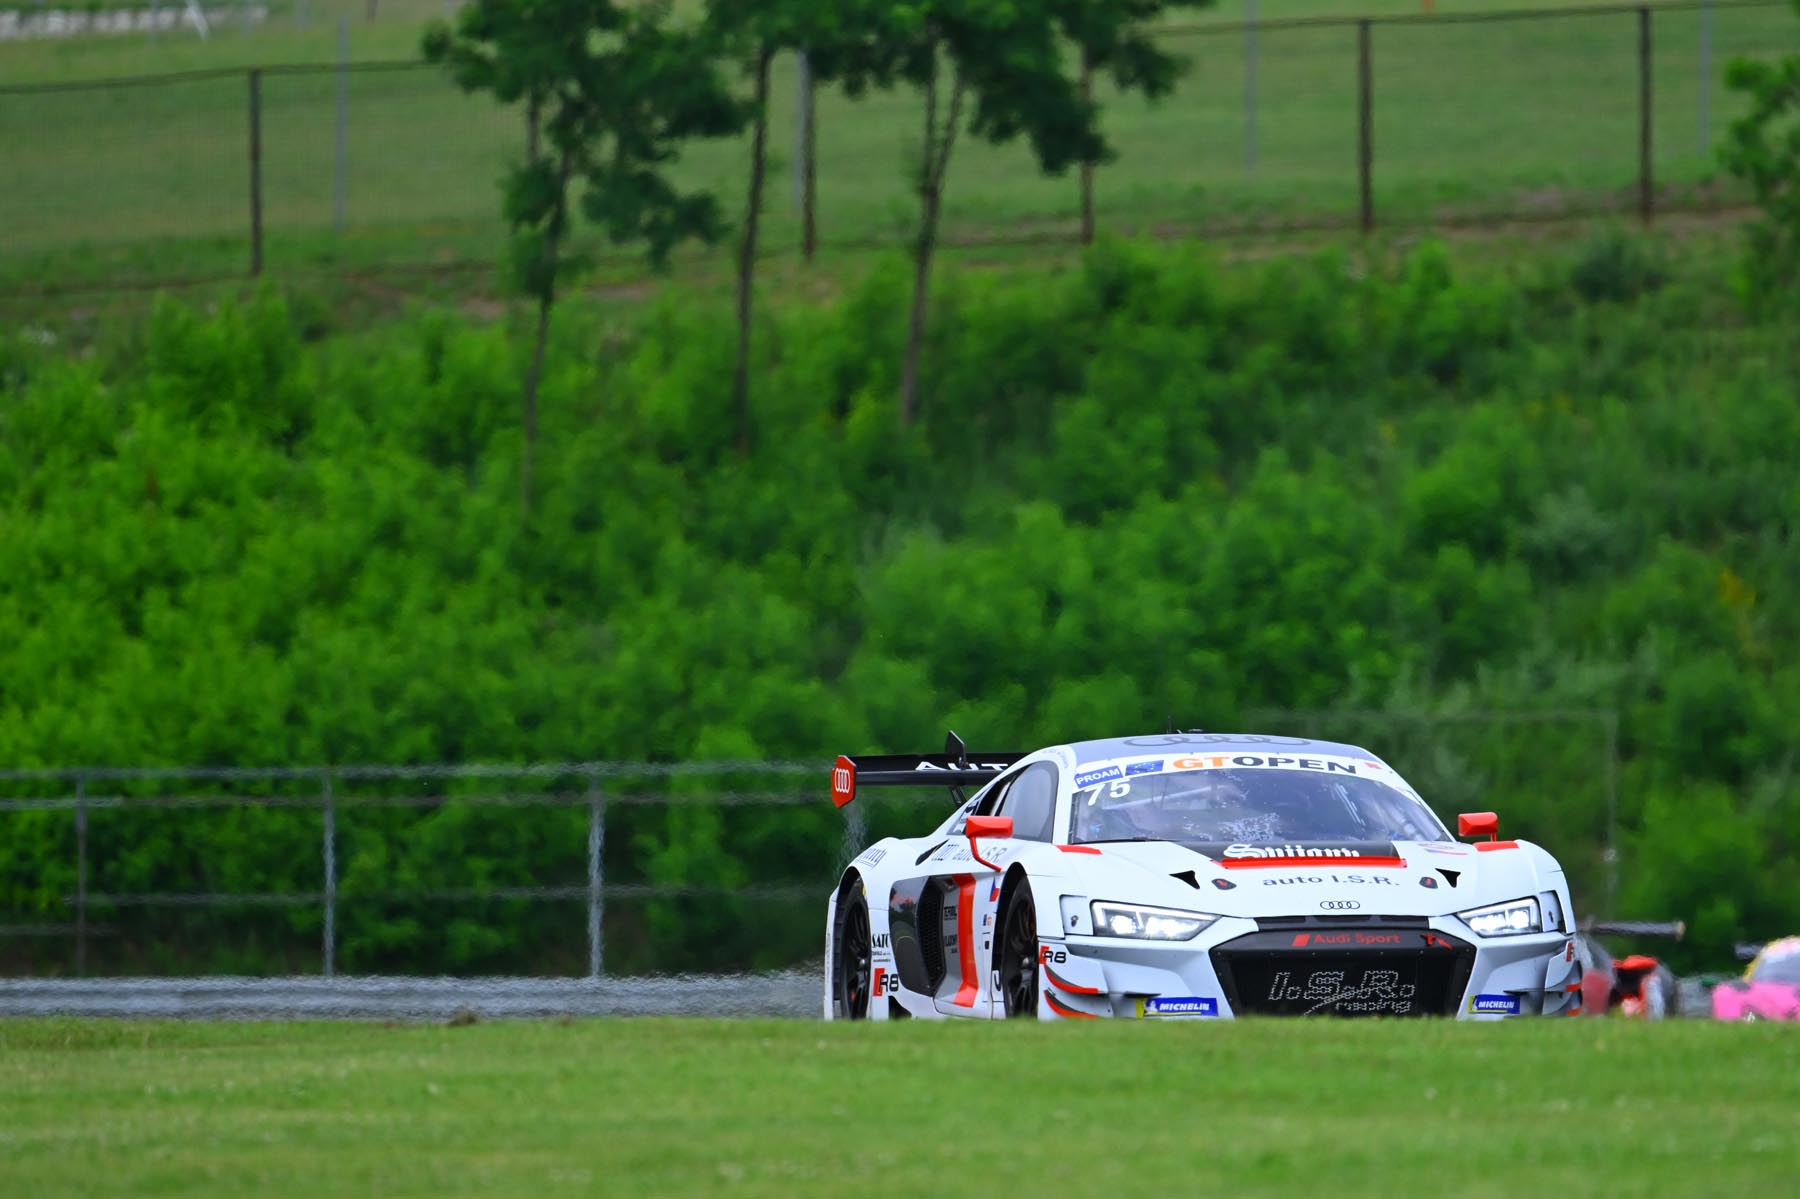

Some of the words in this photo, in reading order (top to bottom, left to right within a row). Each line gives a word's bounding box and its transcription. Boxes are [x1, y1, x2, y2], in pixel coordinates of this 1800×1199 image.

[1076, 768, 1120, 785] PROAM
[1083, 779, 1131, 807] 75
[1263, 876, 1323, 885] auto
[1314, 933, 1350, 944] Audi
[1355, 933, 1401, 946] Sport
[1044, 950, 1067, 963] R8
[878, 973, 899, 993] R8
[1159, 1003, 1210, 1011] MICHELIN
[1477, 1001, 1515, 1009] MICHELIN
